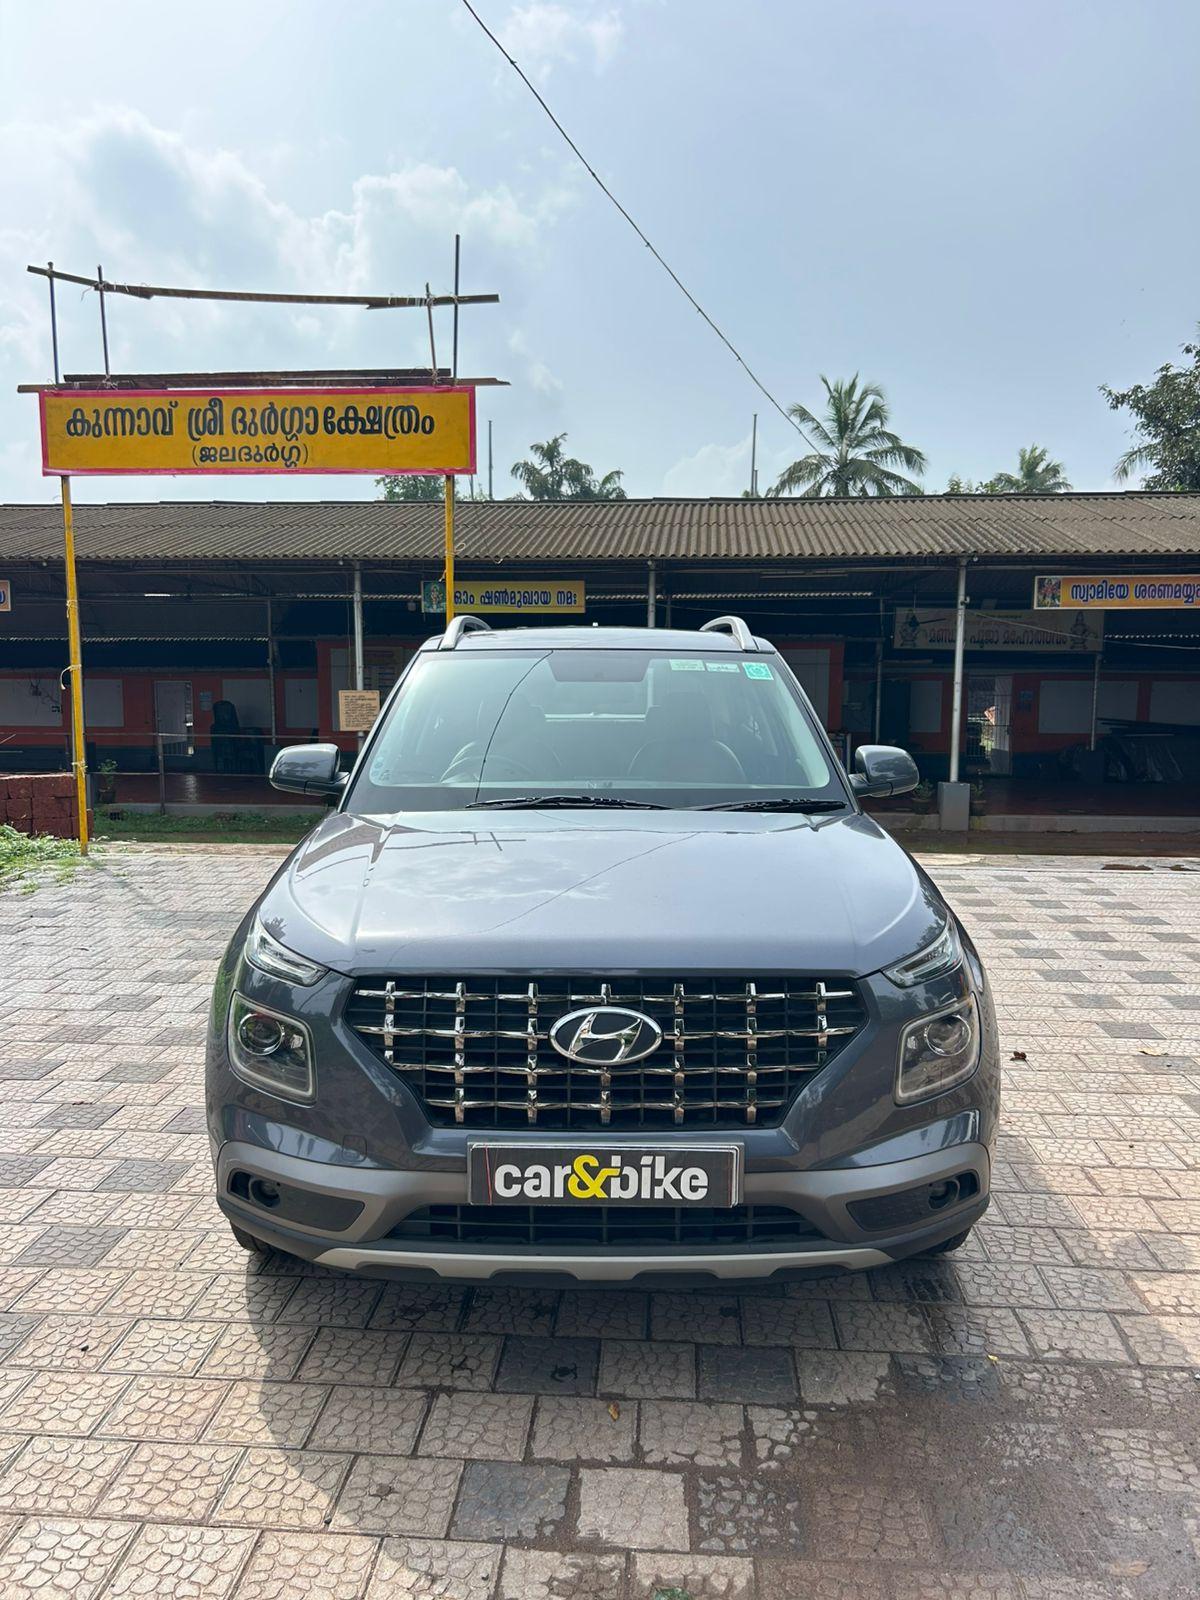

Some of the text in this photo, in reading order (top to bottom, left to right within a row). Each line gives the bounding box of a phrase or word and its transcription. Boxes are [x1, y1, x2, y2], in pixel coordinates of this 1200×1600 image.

[66, 399, 179, 439] കുന്നാവ്
[187, 397, 224, 442] ശ്രീ
[494, 1153, 709, 1200] car&bike
